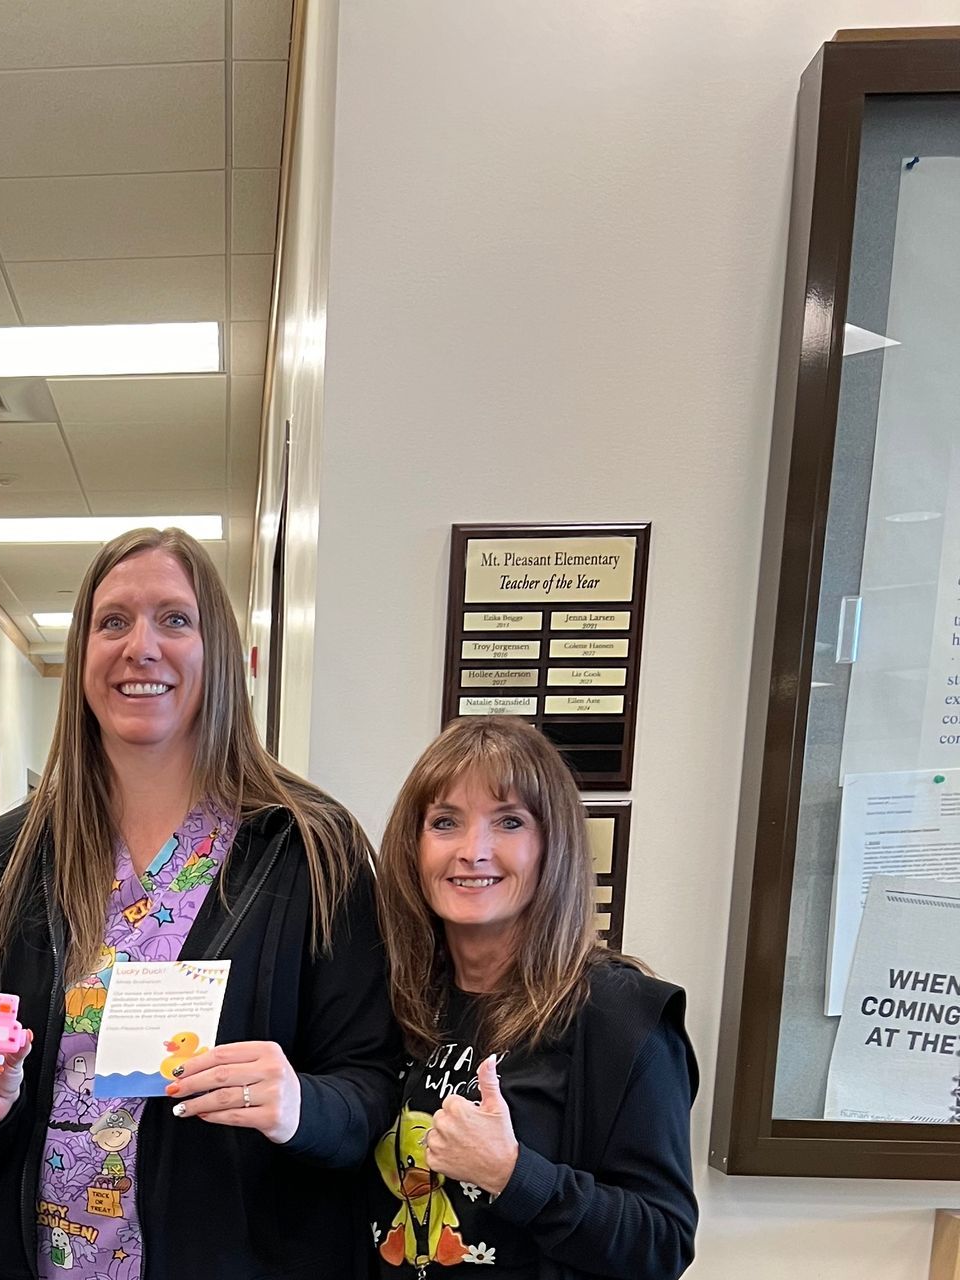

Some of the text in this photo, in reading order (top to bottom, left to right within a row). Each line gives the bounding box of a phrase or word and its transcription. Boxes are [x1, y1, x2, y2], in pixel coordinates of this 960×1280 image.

[481, 552, 620, 569] Mt. Pleasant Elementary
[499, 574, 600, 594] Teacher of the Year
[565, 614, 587, 623] Jenna
[472, 643, 529, 651] Troy Jorgensen
[466, 698, 530, 706] Natalie Stansfield
[116, 968, 140, 976] Lucky
[861, 996, 960, 1025] COMING
[865, 1027, 900, 1048] AT
[92, 1191, 110, 1199] TRICK
[37, 1201, 69, 1219] PPY
